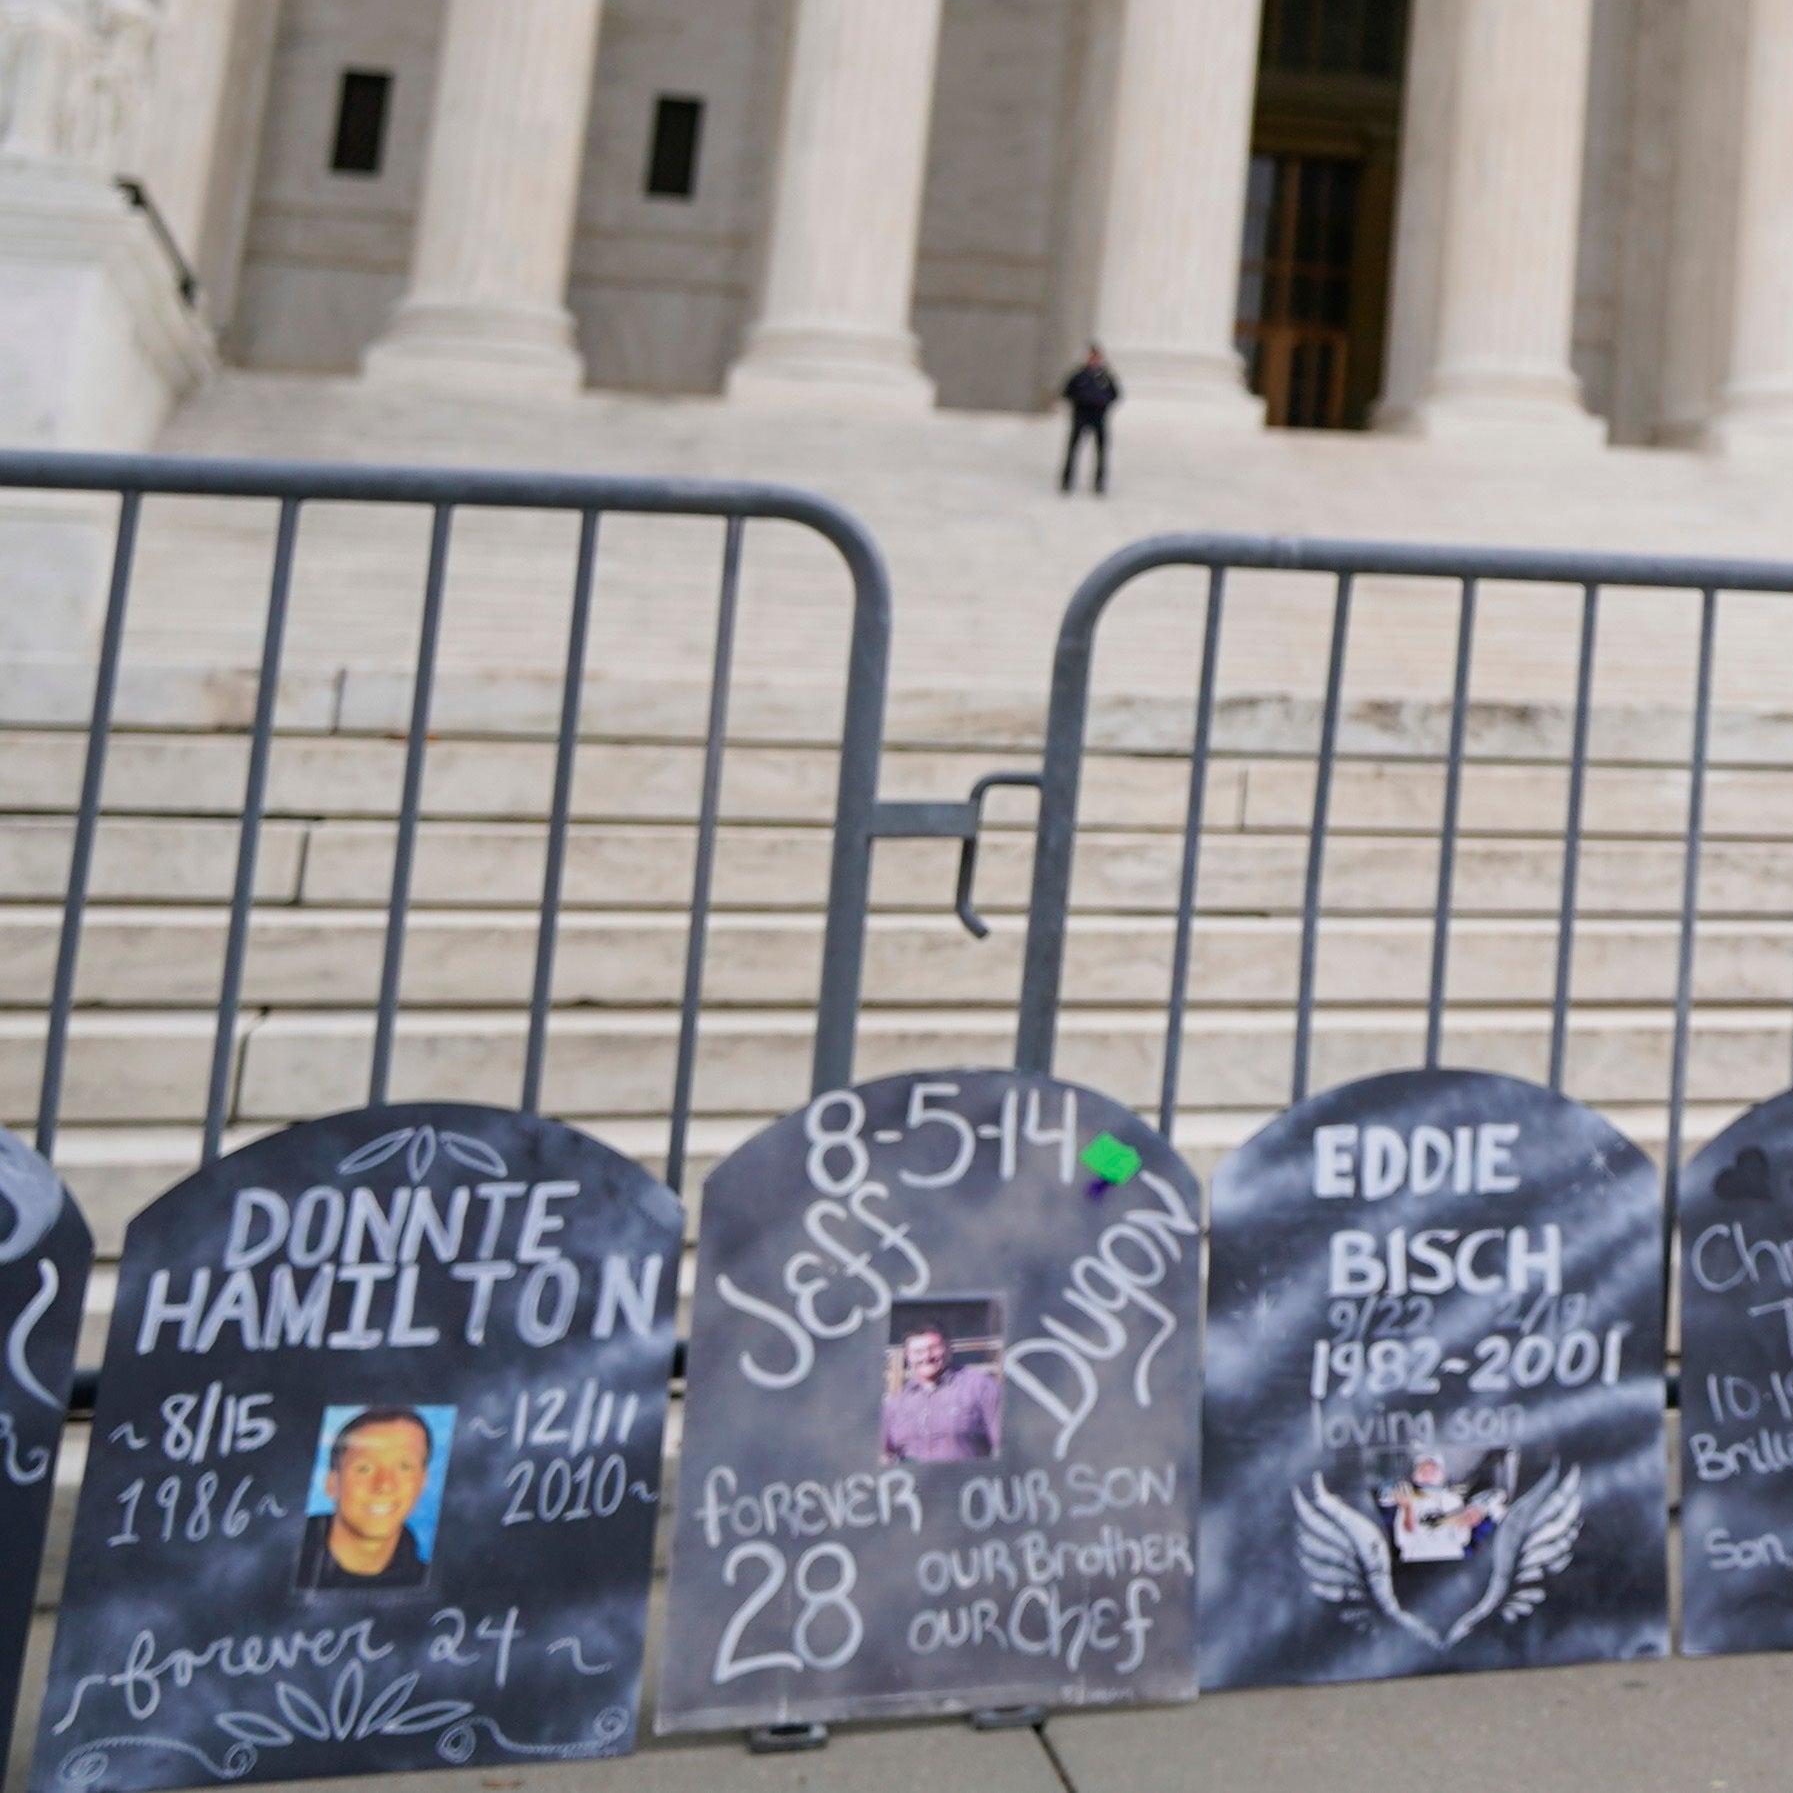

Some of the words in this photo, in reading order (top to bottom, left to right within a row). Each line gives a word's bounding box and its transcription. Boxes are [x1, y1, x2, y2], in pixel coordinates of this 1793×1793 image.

[805, 1082, 1078, 1196] 8-5-14
[1312, 1124, 1520, 1201] EDDIE
[136, 1253, 665, 1355] HAMILTON
[1329, 1224, 1563, 1298] BISCH
[430, 1608, 523, 1685] 24
[714, 1541, 864, 1685] 28
